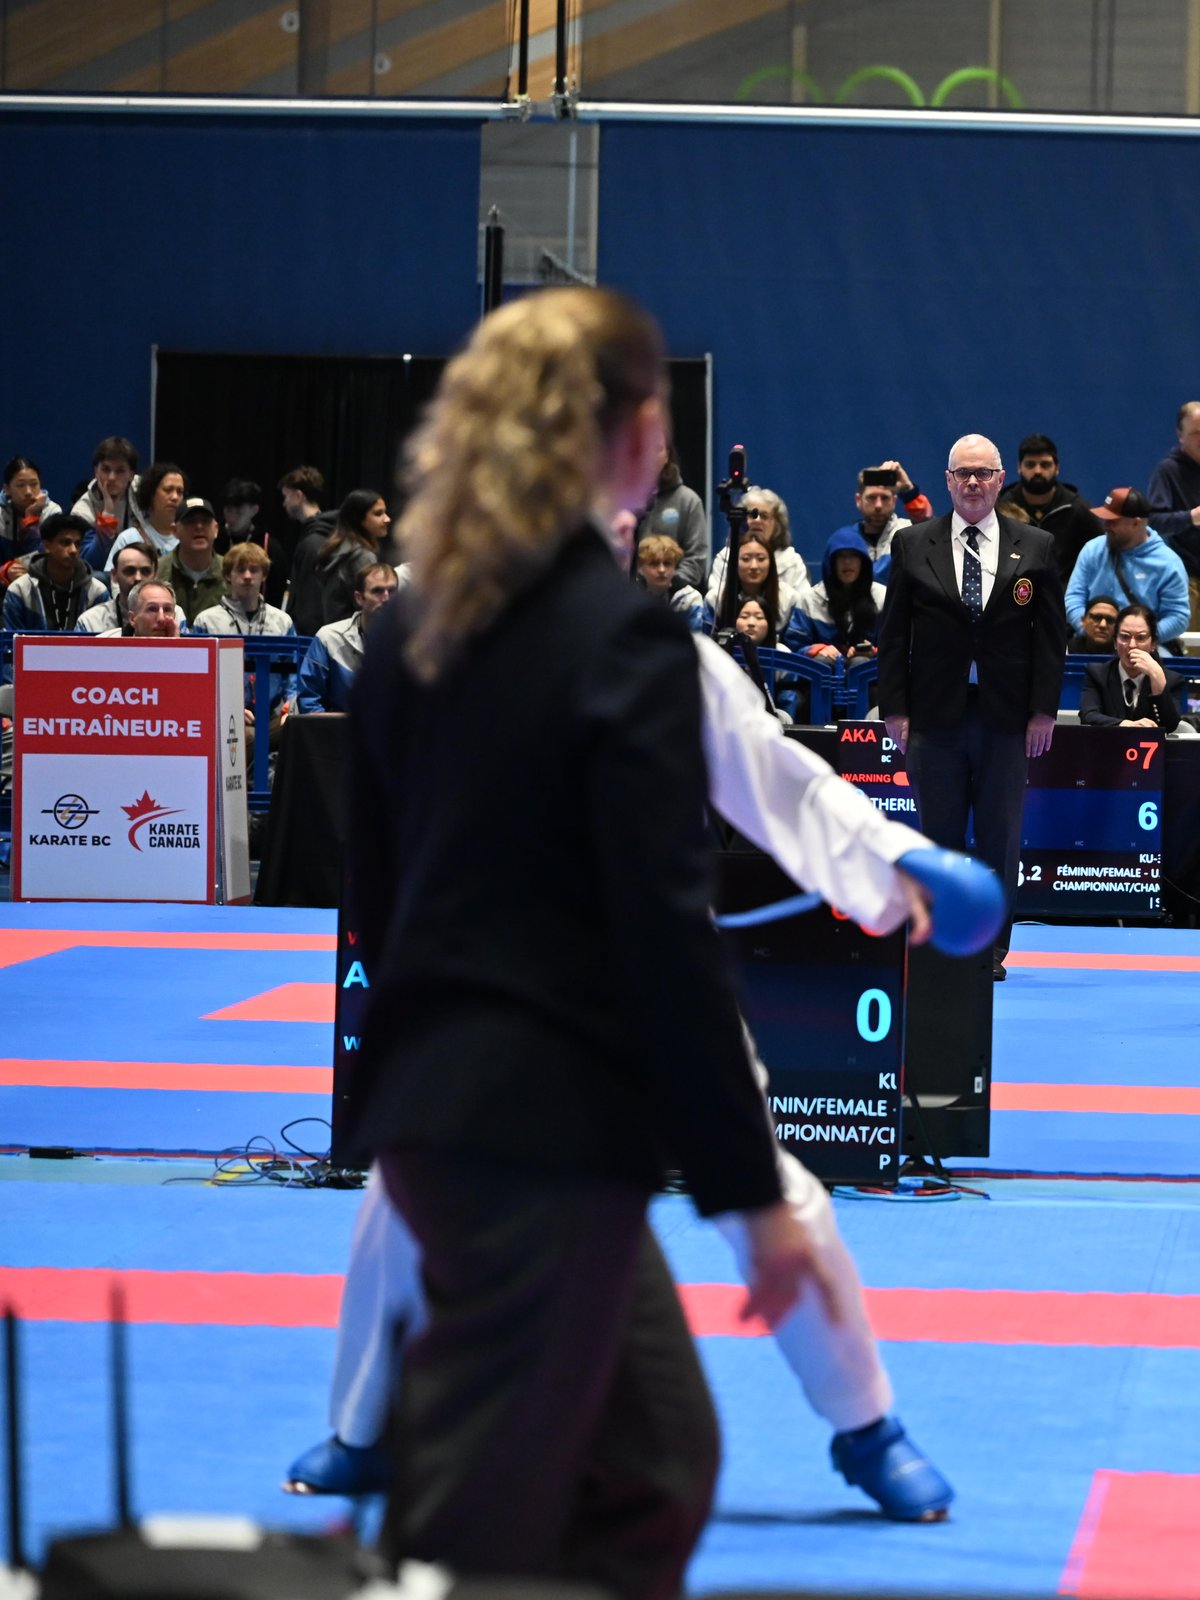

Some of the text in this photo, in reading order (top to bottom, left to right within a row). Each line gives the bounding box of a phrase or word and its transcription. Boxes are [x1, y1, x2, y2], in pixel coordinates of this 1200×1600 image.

[71, 686, 159, 705] COACH
[23, 713, 202, 738] ENTRAÎNEUR·E
[840, 728, 877, 743] AKA
[881, 754, 892, 763] BC
[841, 772, 891, 784] WARNING
[1138, 801, 1158, 831] 6
[148, 823, 200, 836] KARATE
[29, 834, 111, 847] KARATE BC
[148, 836, 201, 849] CANADA
[1056, 864, 1141, 878] FÉMININ/FEMALE
[856, 988, 892, 1043] 0
